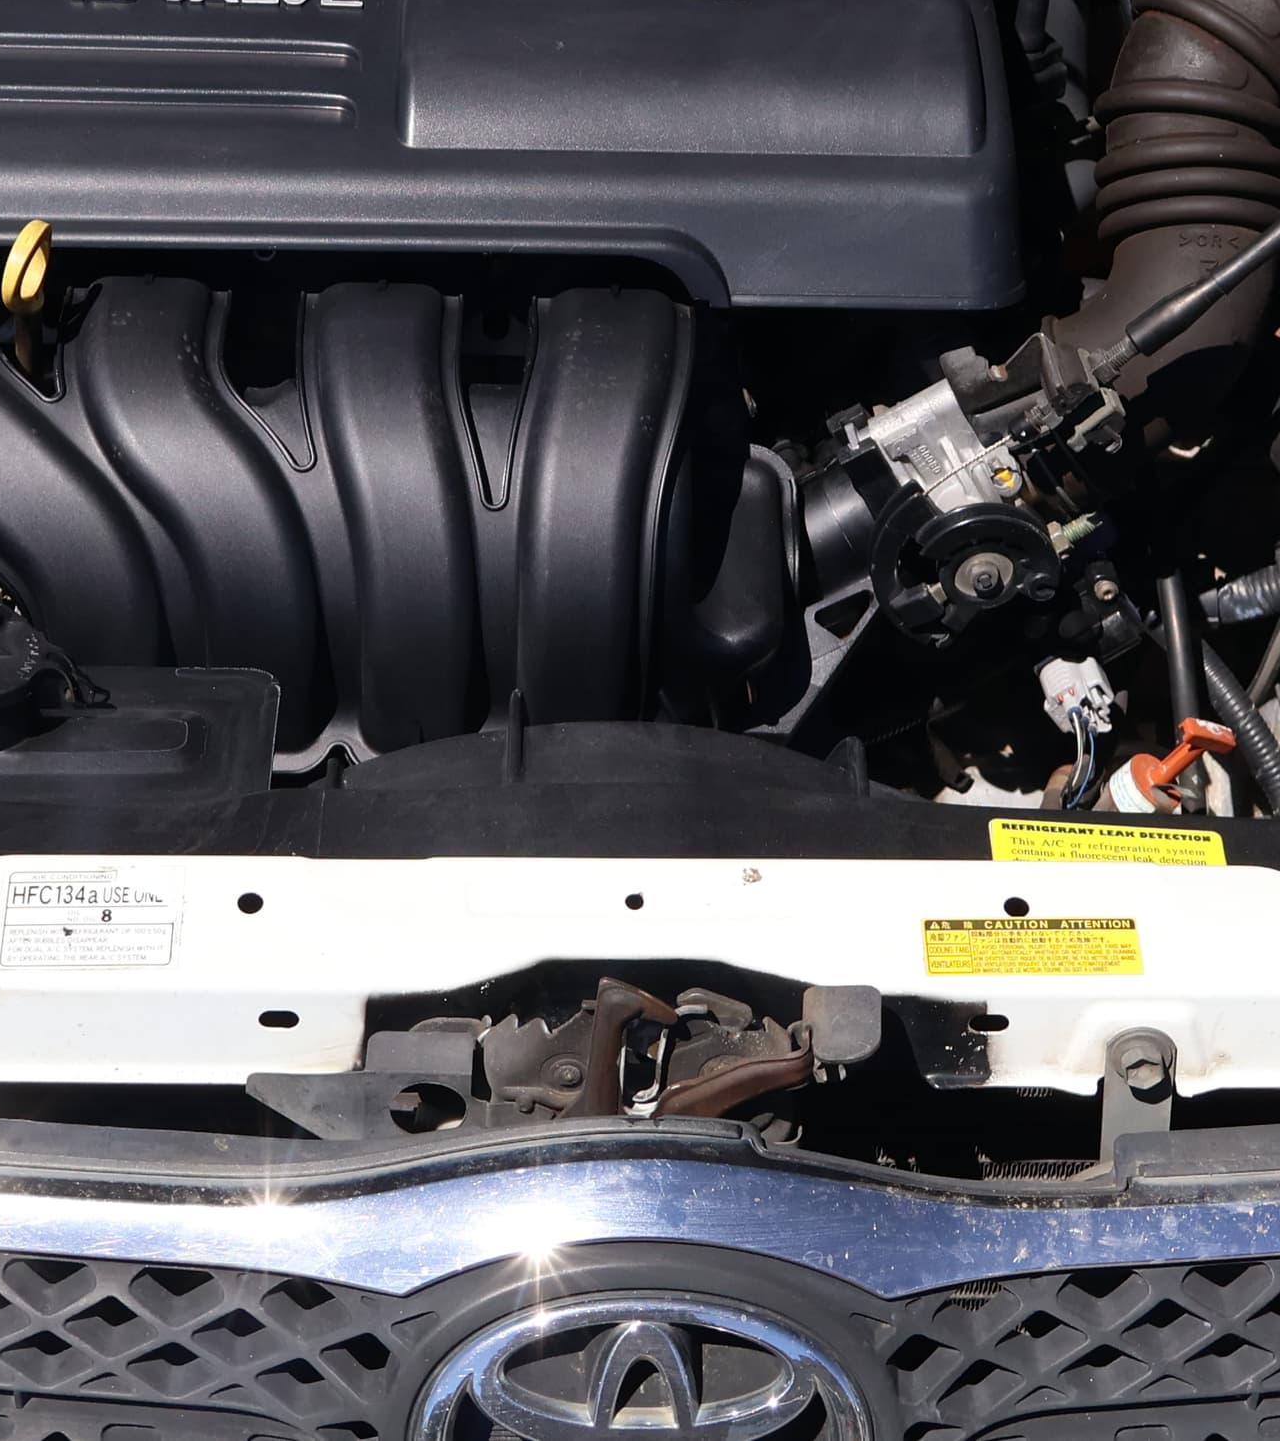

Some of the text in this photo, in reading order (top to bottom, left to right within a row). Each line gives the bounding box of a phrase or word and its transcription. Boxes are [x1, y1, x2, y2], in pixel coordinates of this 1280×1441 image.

[1001, 823, 1211, 842] REFRIGERANT LEAK DETECTION
[1010, 837, 1035, 846] This
[1042, 839, 1064, 848] A/C
[1088, 842, 1160, 854] refrigeration
[1166, 847, 1206, 857] system
[1011, 848, 1055, 857] contains
[1070, 850, 1128, 862] fluorescent
[1133, 854, 1153, 863] leak
[1159, 856, 1207, 866] detection
[103, 886, 130, 904] USE
[101, 909, 112, 922] 8
[984, 919, 1131, 929] CAUTION ATTENTION
